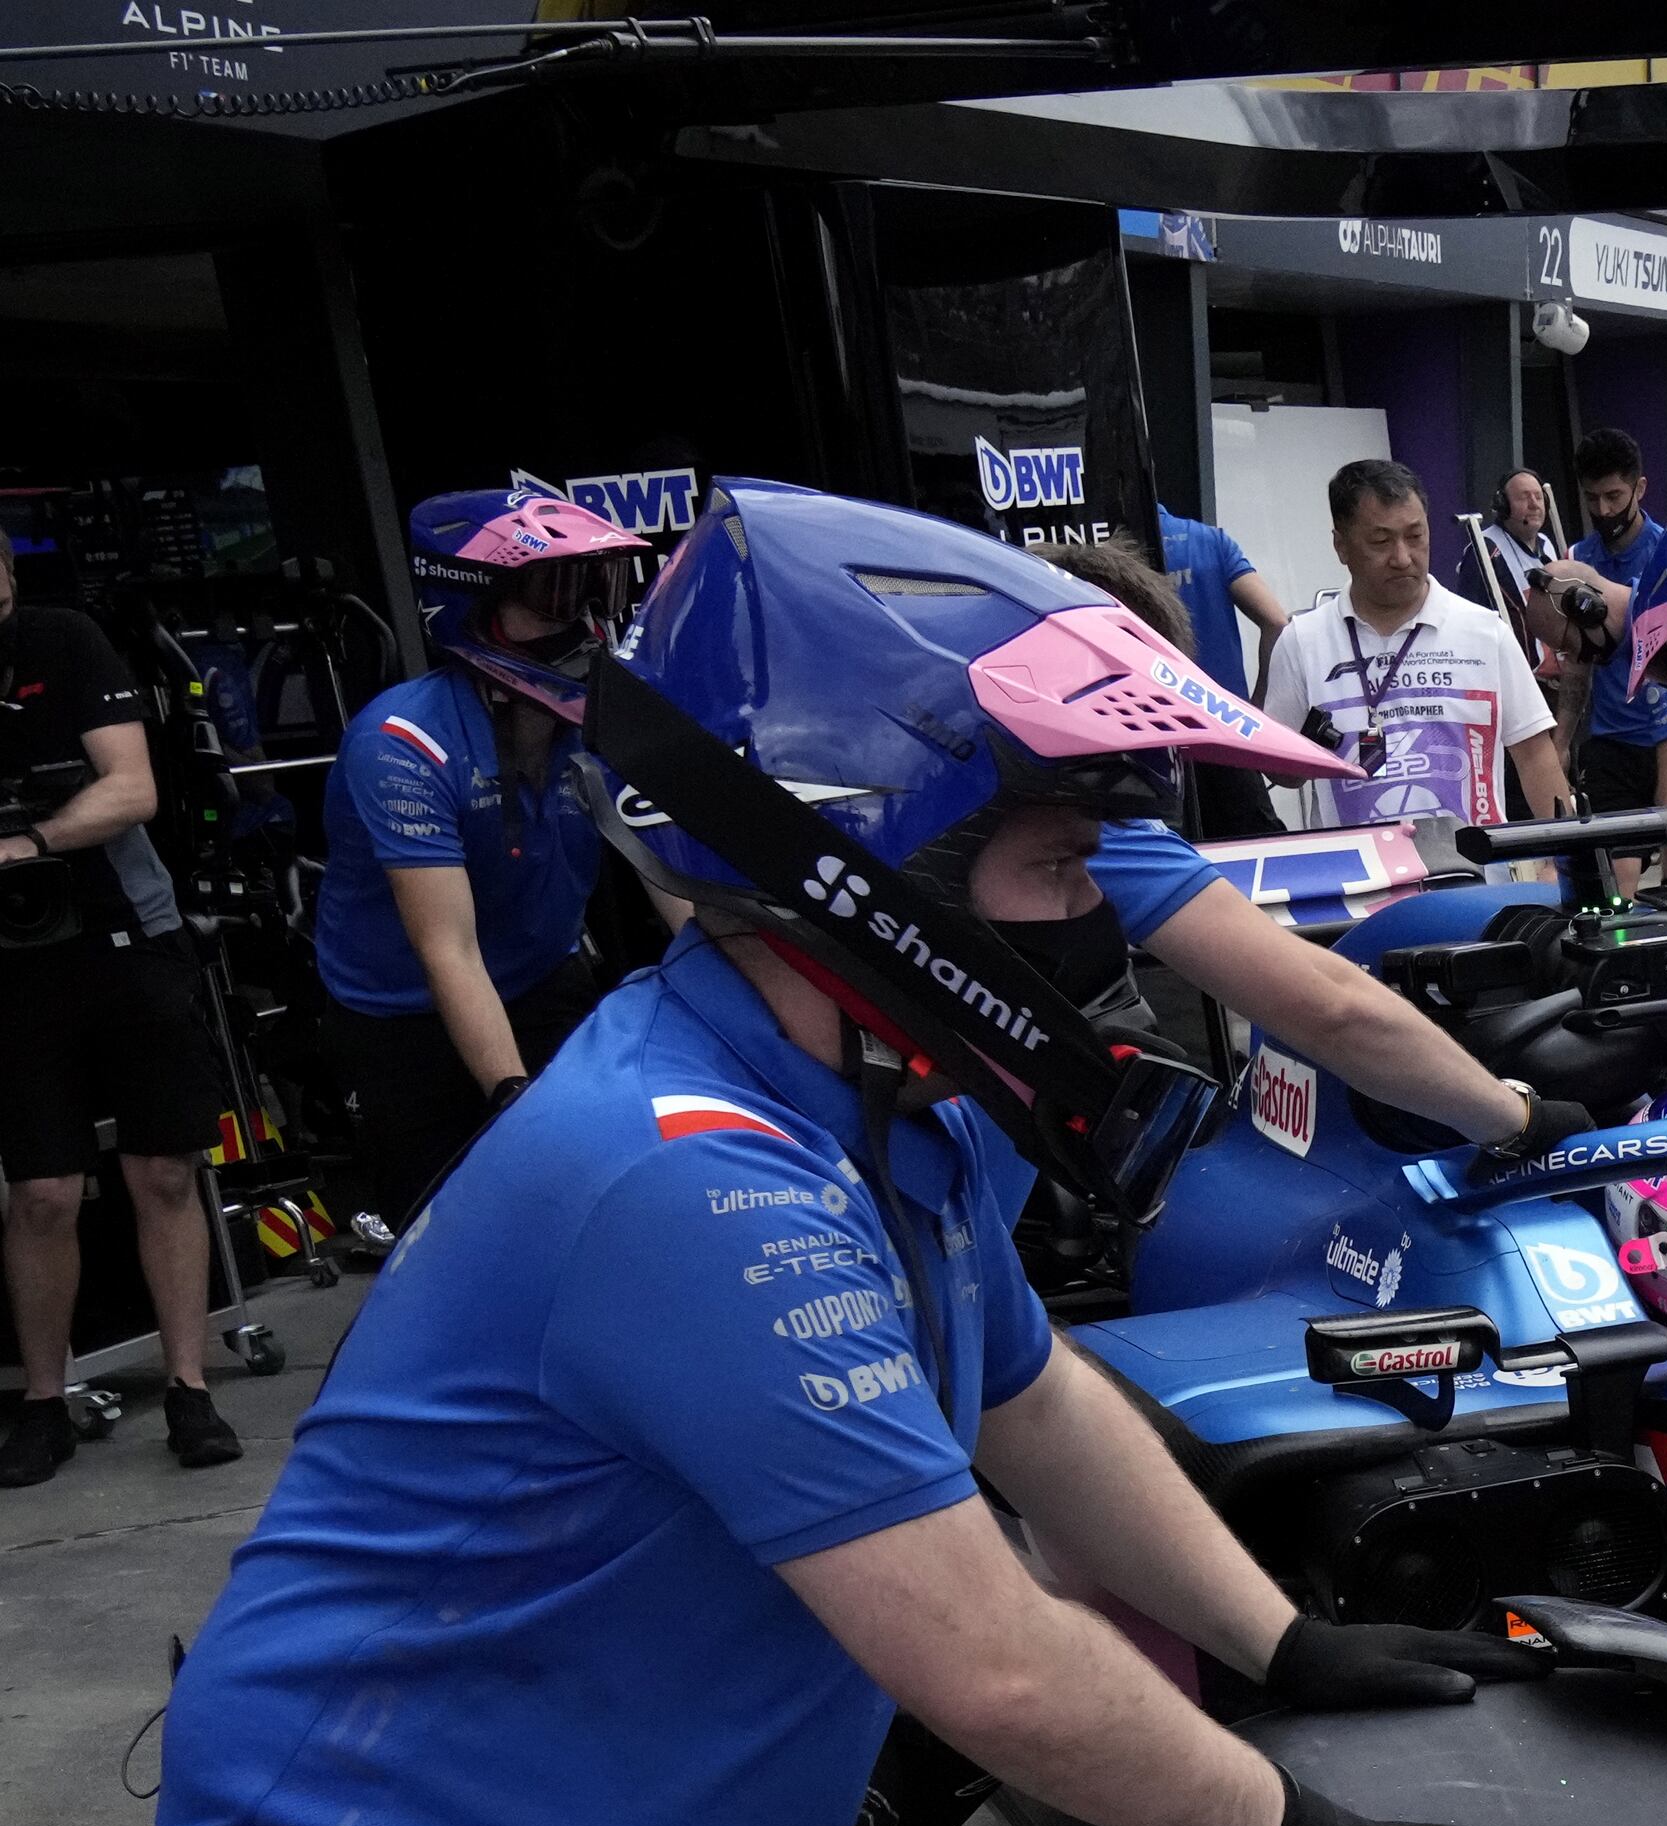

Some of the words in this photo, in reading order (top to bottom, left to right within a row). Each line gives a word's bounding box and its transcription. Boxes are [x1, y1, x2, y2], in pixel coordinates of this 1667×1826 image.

[122, 0, 283, 53] ALPINE
[199, 56, 249, 81] TEAM
[1363, 222, 1442, 264] ALPHATAURI
[1539, 226, 1563, 287] 22
[1595, 243, 1629, 286] YUKI
[1010, 447, 1084, 508] BWT
[567, 467, 699, 534] BWT
[520, 533, 549, 553] BWT
[429, 563, 494, 586] shamir
[1402, 658, 1427, 666] World
[1415, 650, 1450, 658] Formula
[1180, 678, 1263, 742] BWT
[403, 823, 441, 837] BWT
[867, 911, 1050, 1051] shamir
[1258, 1054, 1310, 1143] Castrol
[710, 1187, 815, 1215] ultimate
[1326, 1235, 1380, 1286] ultimate
[1400, 1229, 1412, 1252] bp
[743, 1247, 880, 1285] E-TECH
[787, 1290, 884, 1340] DUPONT
[1556, 1299, 1639, 1329] BWT
[848, 1352, 921, 1404] BWT
[1378, 1345, 1453, 1373] Castrol
